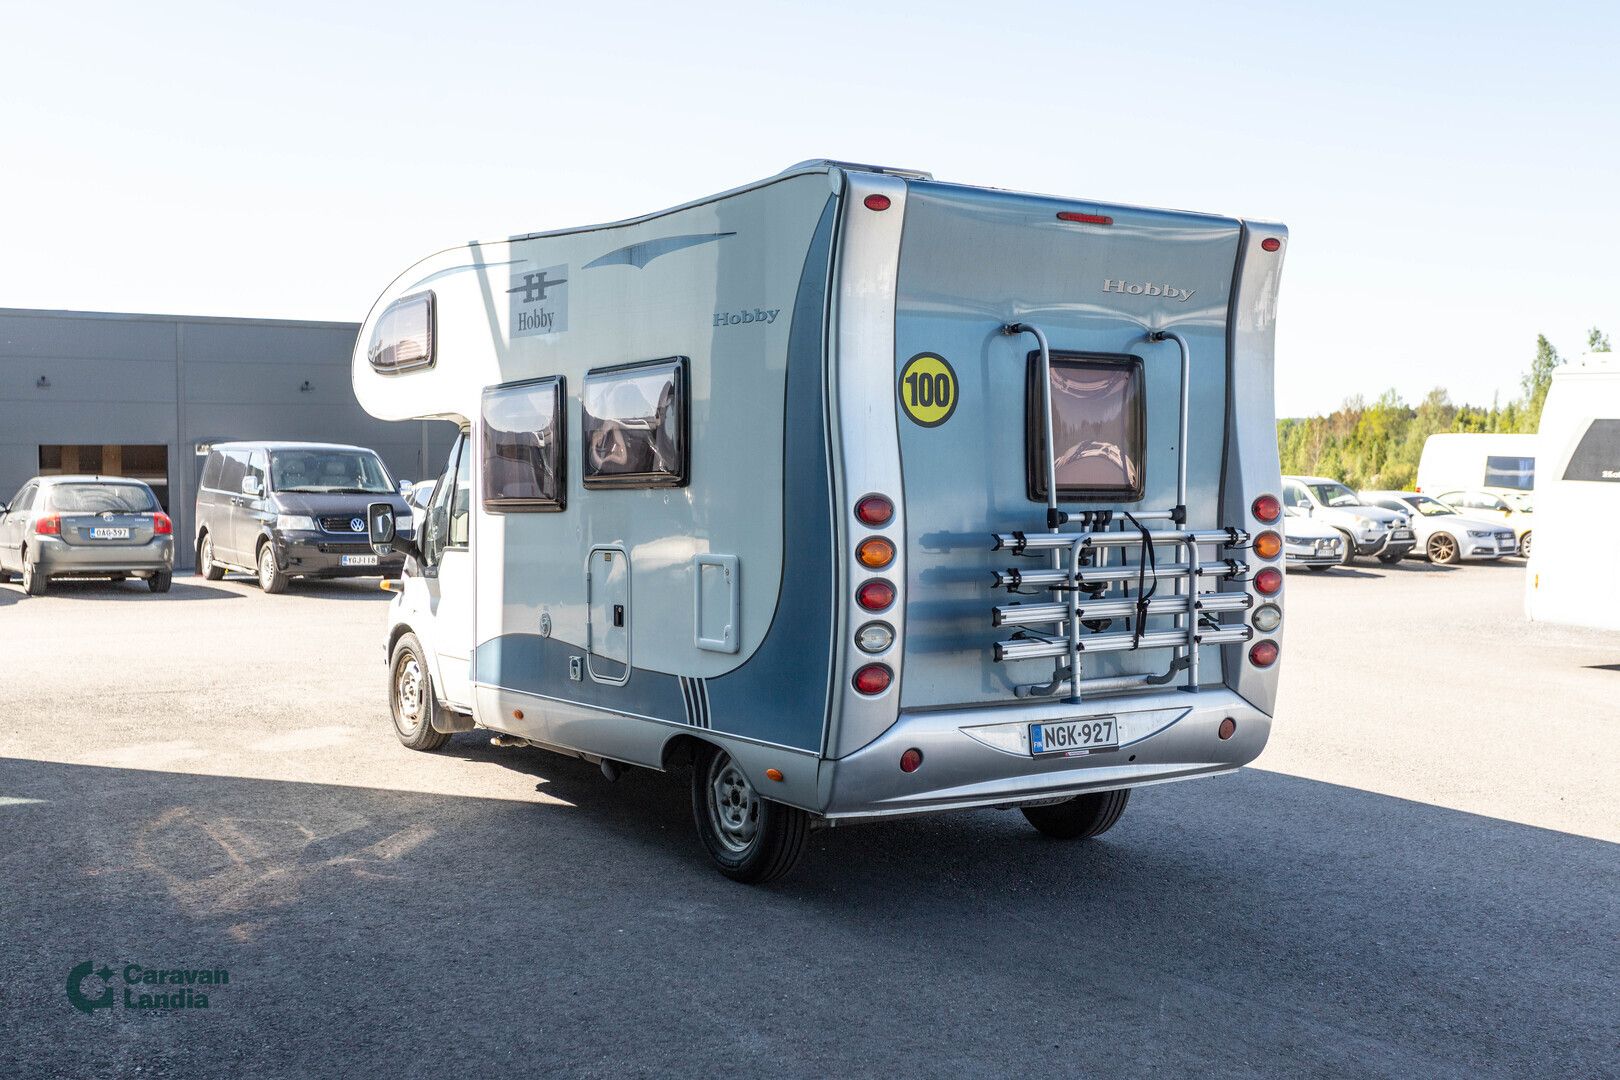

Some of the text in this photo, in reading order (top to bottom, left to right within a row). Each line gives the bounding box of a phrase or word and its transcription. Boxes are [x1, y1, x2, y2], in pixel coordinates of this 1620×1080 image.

[1101, 278, 1197, 302] Hobby
[518, 308, 555, 332] Hobby
[712, 308, 781, 327] Hobby
[904, 371, 951, 408] 100
[1044, 721, 1113, 748] NGK-927
